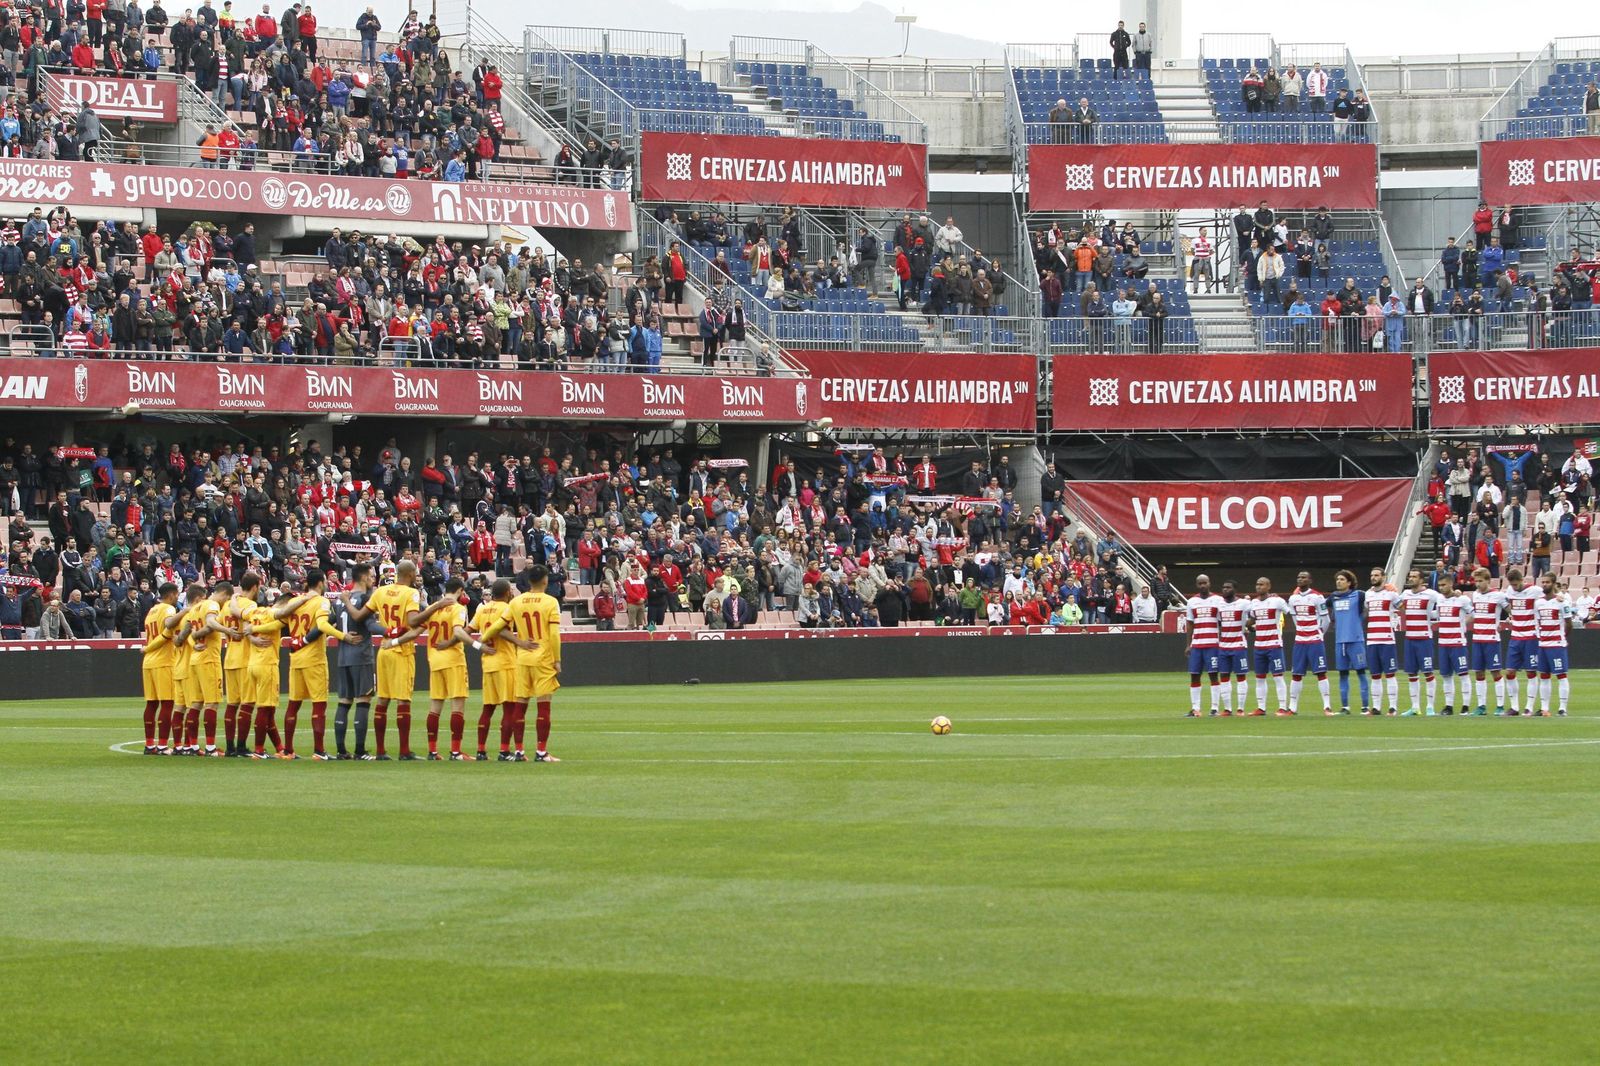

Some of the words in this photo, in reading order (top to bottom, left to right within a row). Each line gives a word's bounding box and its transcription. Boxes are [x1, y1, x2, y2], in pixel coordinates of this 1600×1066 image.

[60, 79, 163, 109] IDEAL
[0, 162, 72, 178] AUTOCARES
[700, 157, 786, 183] CERVEZAS
[791, 160, 886, 187] ALHAMBRA
[888, 164, 902, 177] SIN
[1104, 166, 1203, 189] CERVEZAS
[1209, 166, 1321, 188] ALHAMBRA
[1323, 166, 1340, 178] SIN
[1543, 159, 1600, 182] CERVE
[124, 175, 252, 203] grupo2000
[465, 184, 511, 194] CENTRO
[519, 187, 587, 198] COMERCIAL
[465, 197, 590, 227] NEPTUNO
[0, 375, 48, 400] AN
[127, 366, 176, 393] BMN
[217, 369, 265, 395] BMN
[305, 371, 352, 397] BMN
[392, 373, 438, 399] BMN
[477, 375, 522, 401] BMN
[560, 378, 605, 403] BMN
[821, 377, 909, 403] CERVEZAS
[914, 379, 1013, 405] ALHAMBRA
[1014, 381, 1029, 394] SIN
[1129, 380, 1233, 404] CERVEZAS
[1239, 380, 1357, 403] ALHAMBRA
[1360, 379, 1377, 392] SIN
[1473, 375, 1572, 401] CERVEZAS
[1577, 374, 1600, 397] AL
[128, 397, 176, 406] CAJAGRANADA
[219, 400, 266, 408] CAJAGRANADA
[642, 380, 685, 405] BMN
[721, 382, 763, 406] BMN
[308, 401, 353, 410] CAJAGRANADA
[395, 403, 439, 411] CAJAGRANADA
[479, 404, 523, 413] CAJAGRANADA
[562, 406, 605, 415] CAJAGRANADA
[643, 408, 685, 417] CAJAGRANADA
[723, 409, 764, 418] CAJAGRANADA
[1132, 495, 1343, 530] WELCOME
[340, 611, 348, 634] 1
[383, 603, 401, 631] 15
[522, 611, 542, 640] 11
[429, 621, 448, 648] 21
